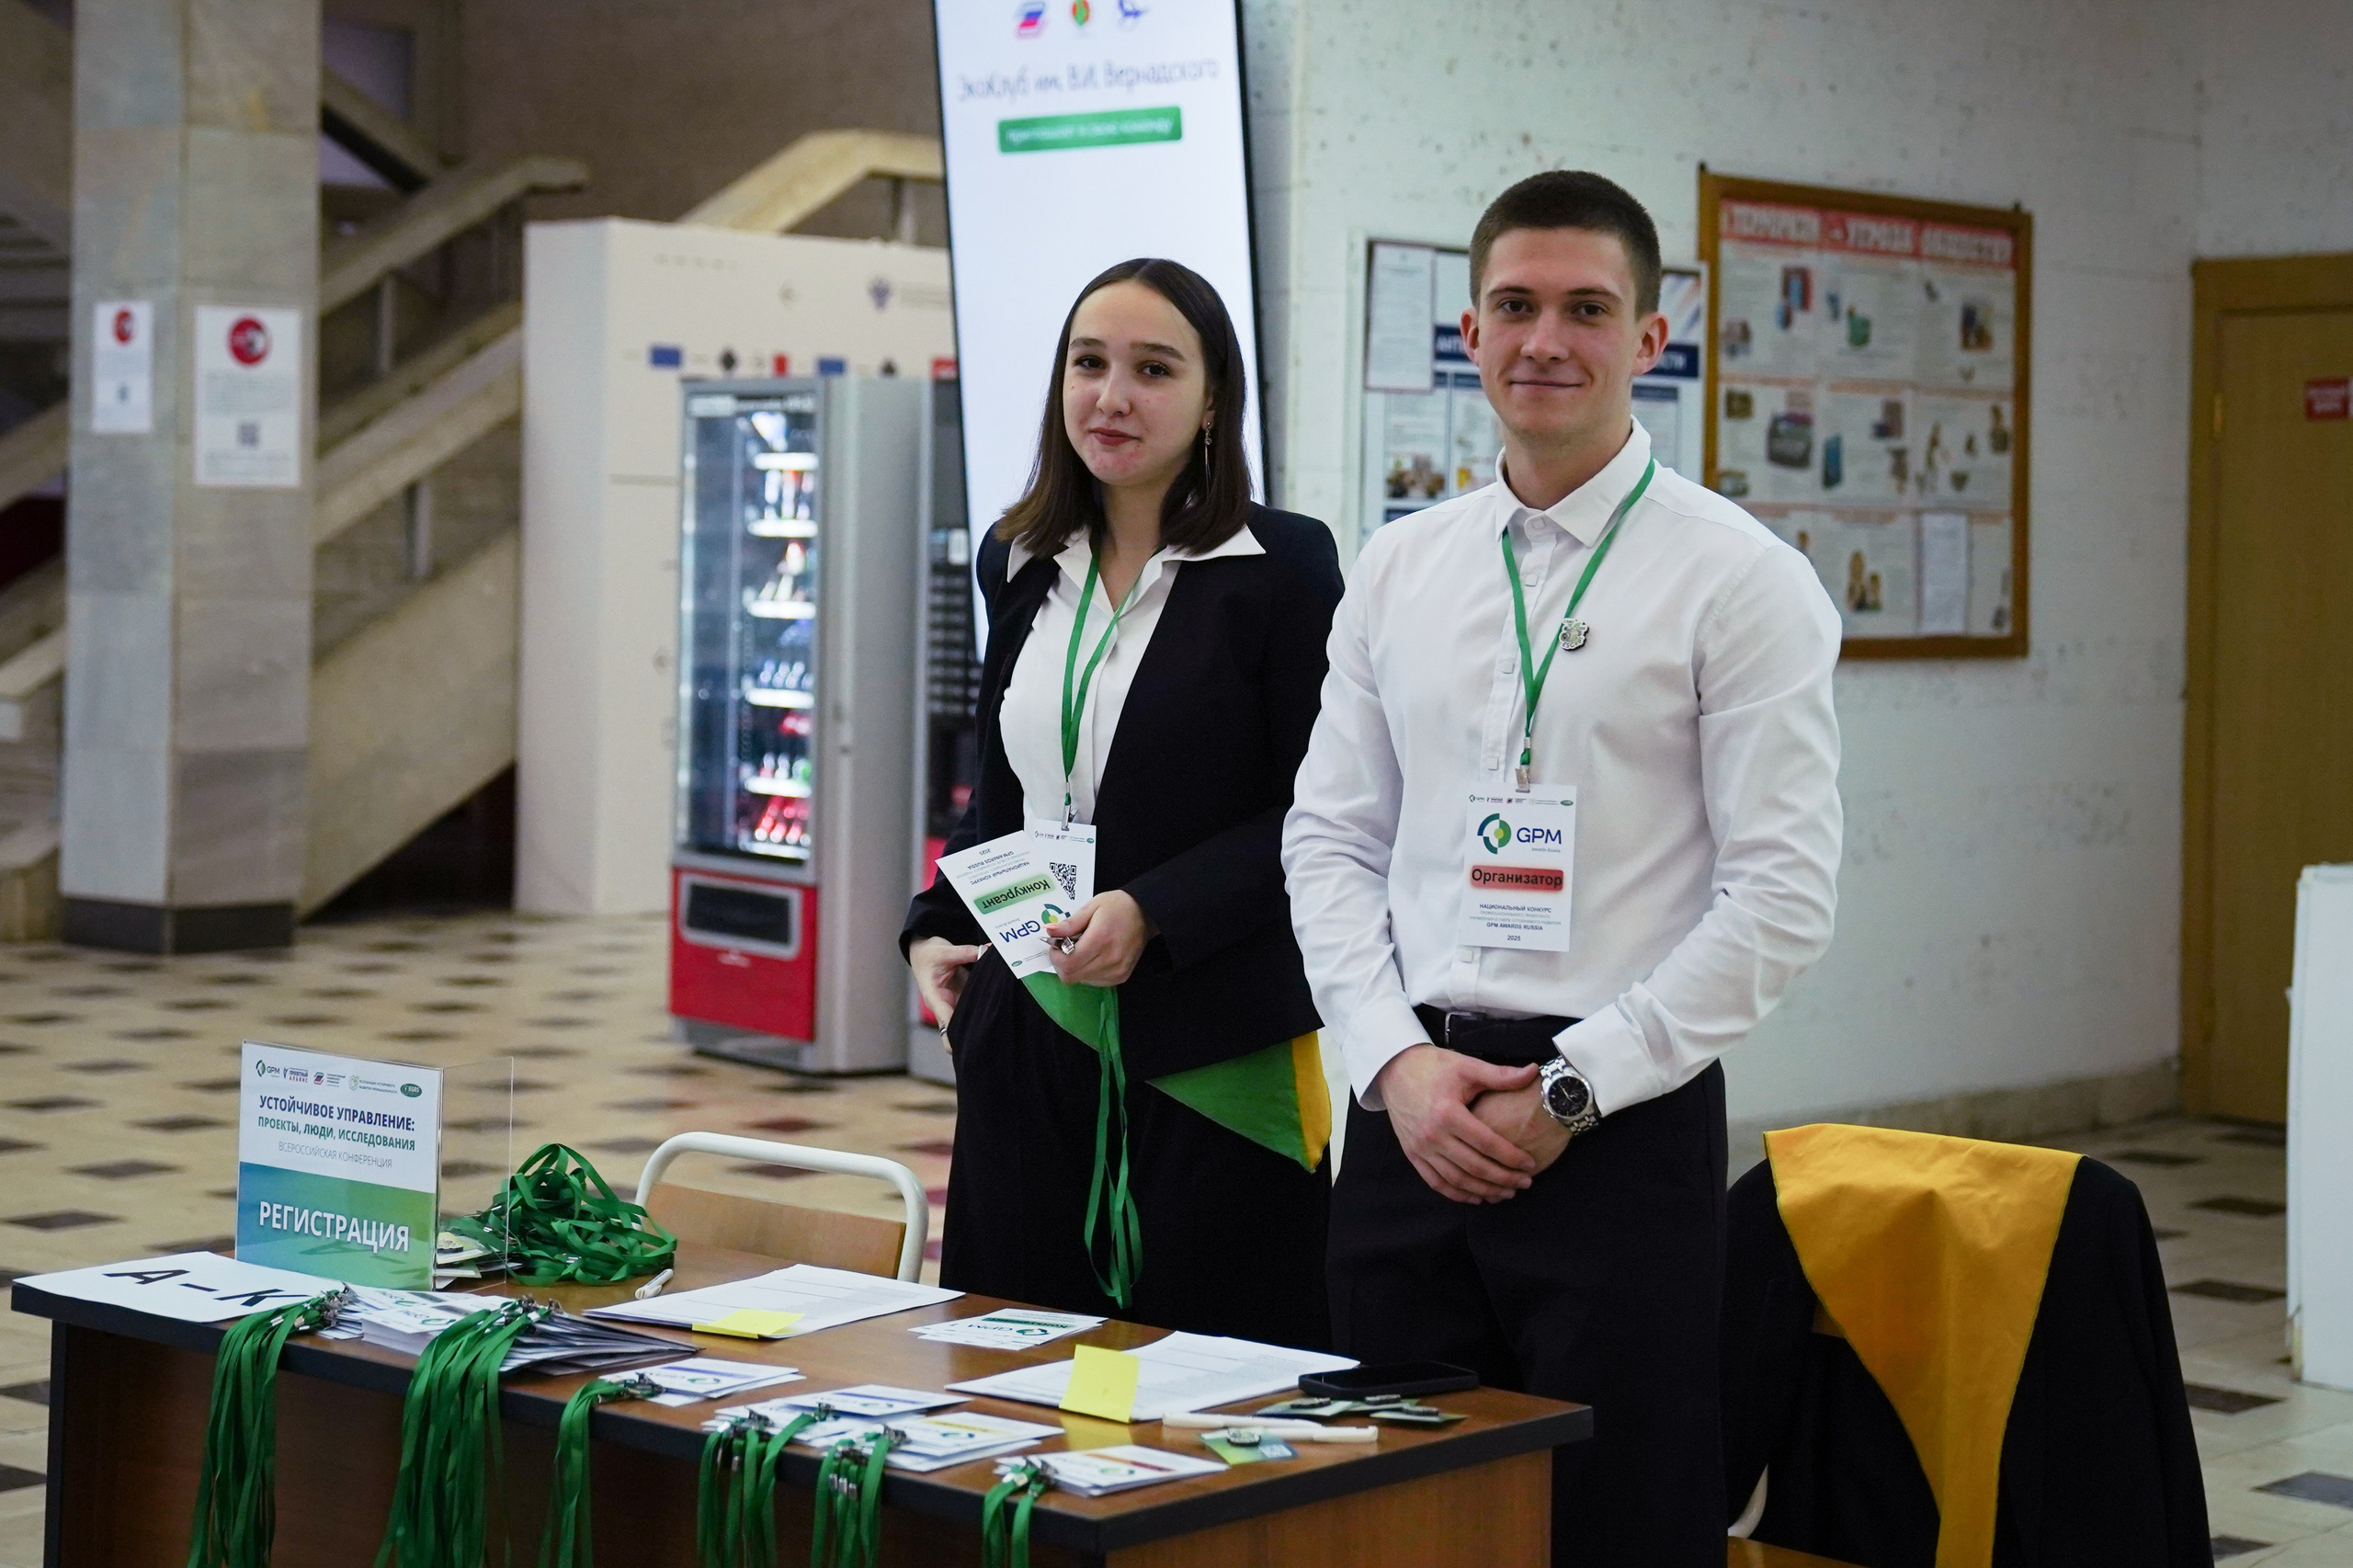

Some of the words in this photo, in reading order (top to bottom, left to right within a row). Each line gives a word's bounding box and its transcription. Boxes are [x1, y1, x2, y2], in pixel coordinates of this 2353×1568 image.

[1517, 827, 1562, 845] GPM
[1472, 869, 1563, 888] Организатор
[983, 880, 1051, 909] Конкурсант
[1479, 903, 1526, 912] НАЦИОНАЛЬНЫЙ
[999, 920, 1040, 943] GPM
[267, 1066, 280, 1074] GPM
[259, 1095, 334, 1119] УСТОЙЧИВОЕ
[336, 1108, 415, 1131] УПРАВЛЕНИЕ:
[258, 1117, 301, 1134] ПРОЕКТЫ,
[303, 1124, 335, 1140] ЛЮДИ,
[338, 1129, 415, 1151] ИССЛЕДОВАНИЯ
[278, 1141, 336, 1160] ВСЕРОССИЙСКАЯ
[338, 1150, 392, 1168] КОНФЕРЕНЦИЯ
[259, 1201, 410, 1254] РЕГИСТРАЦИЯ
